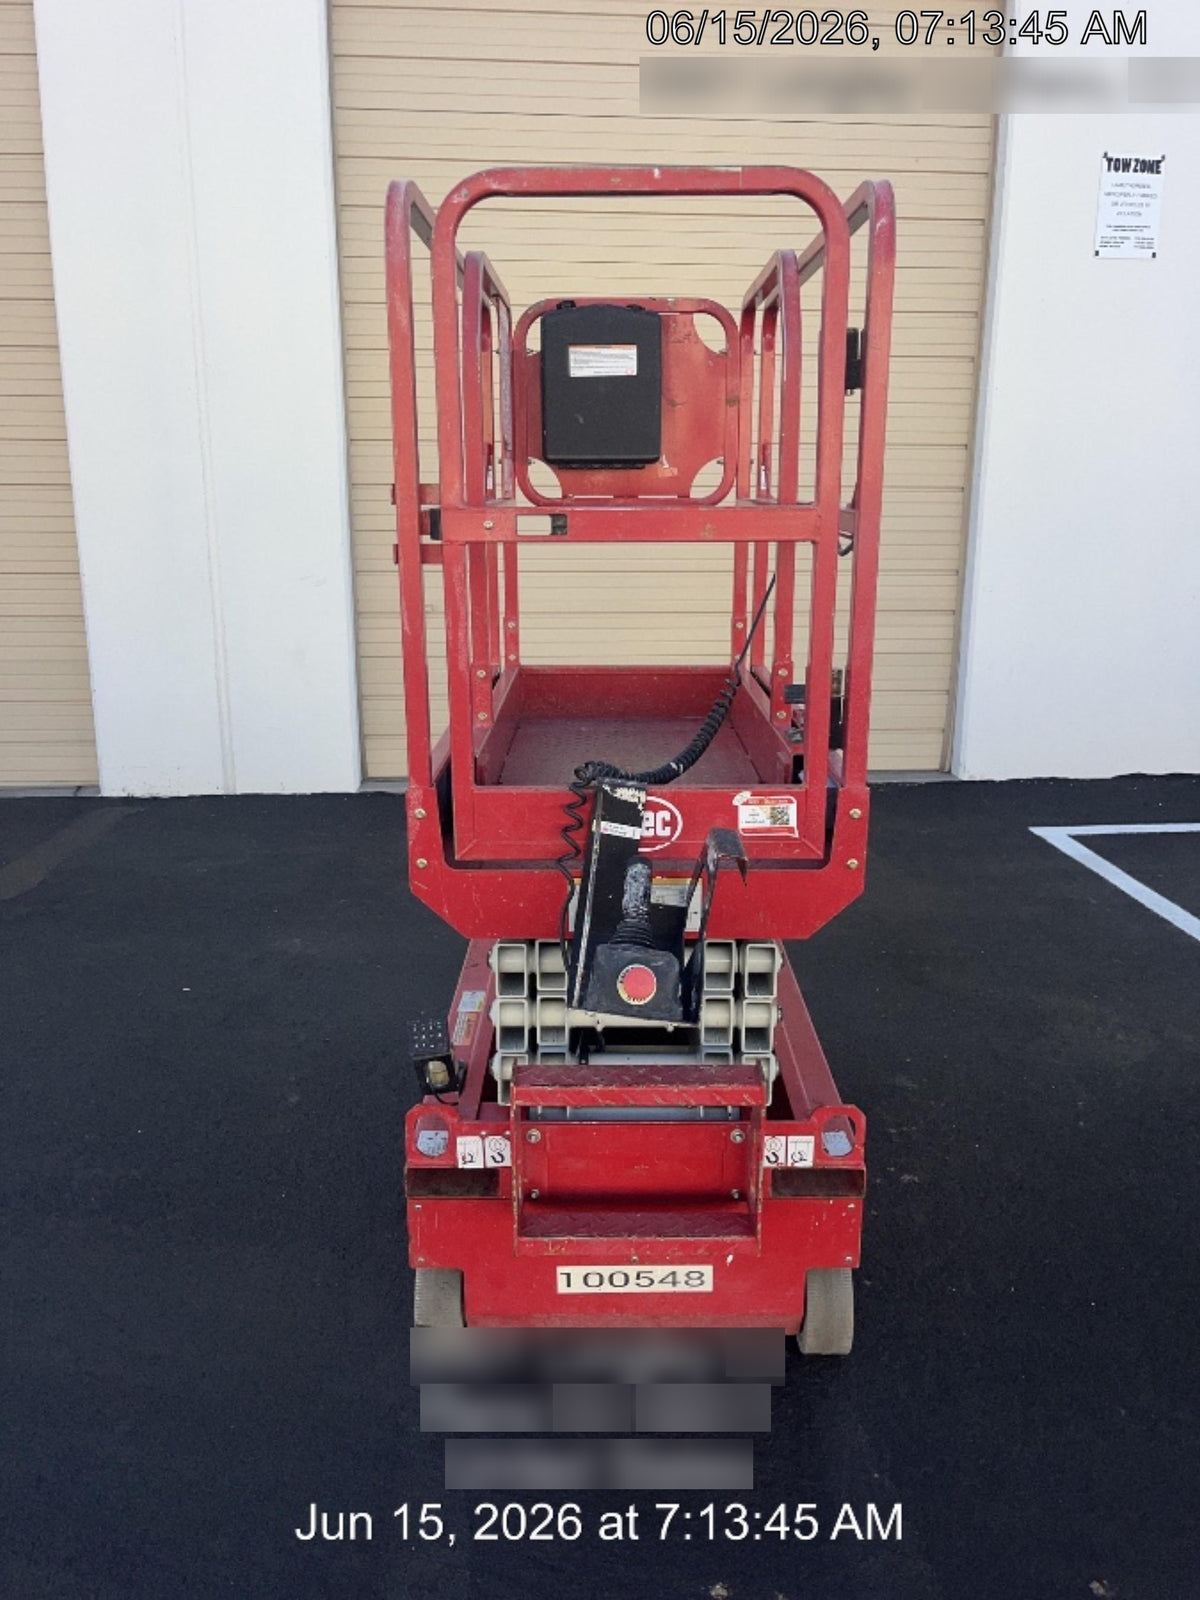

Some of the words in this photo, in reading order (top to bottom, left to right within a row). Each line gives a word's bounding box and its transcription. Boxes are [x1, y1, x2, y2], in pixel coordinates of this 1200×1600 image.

[1106, 157, 1132, 173] TOW
[1132, 158, 1162, 174] ZONE
[559, 1270, 706, 1288] 100548
